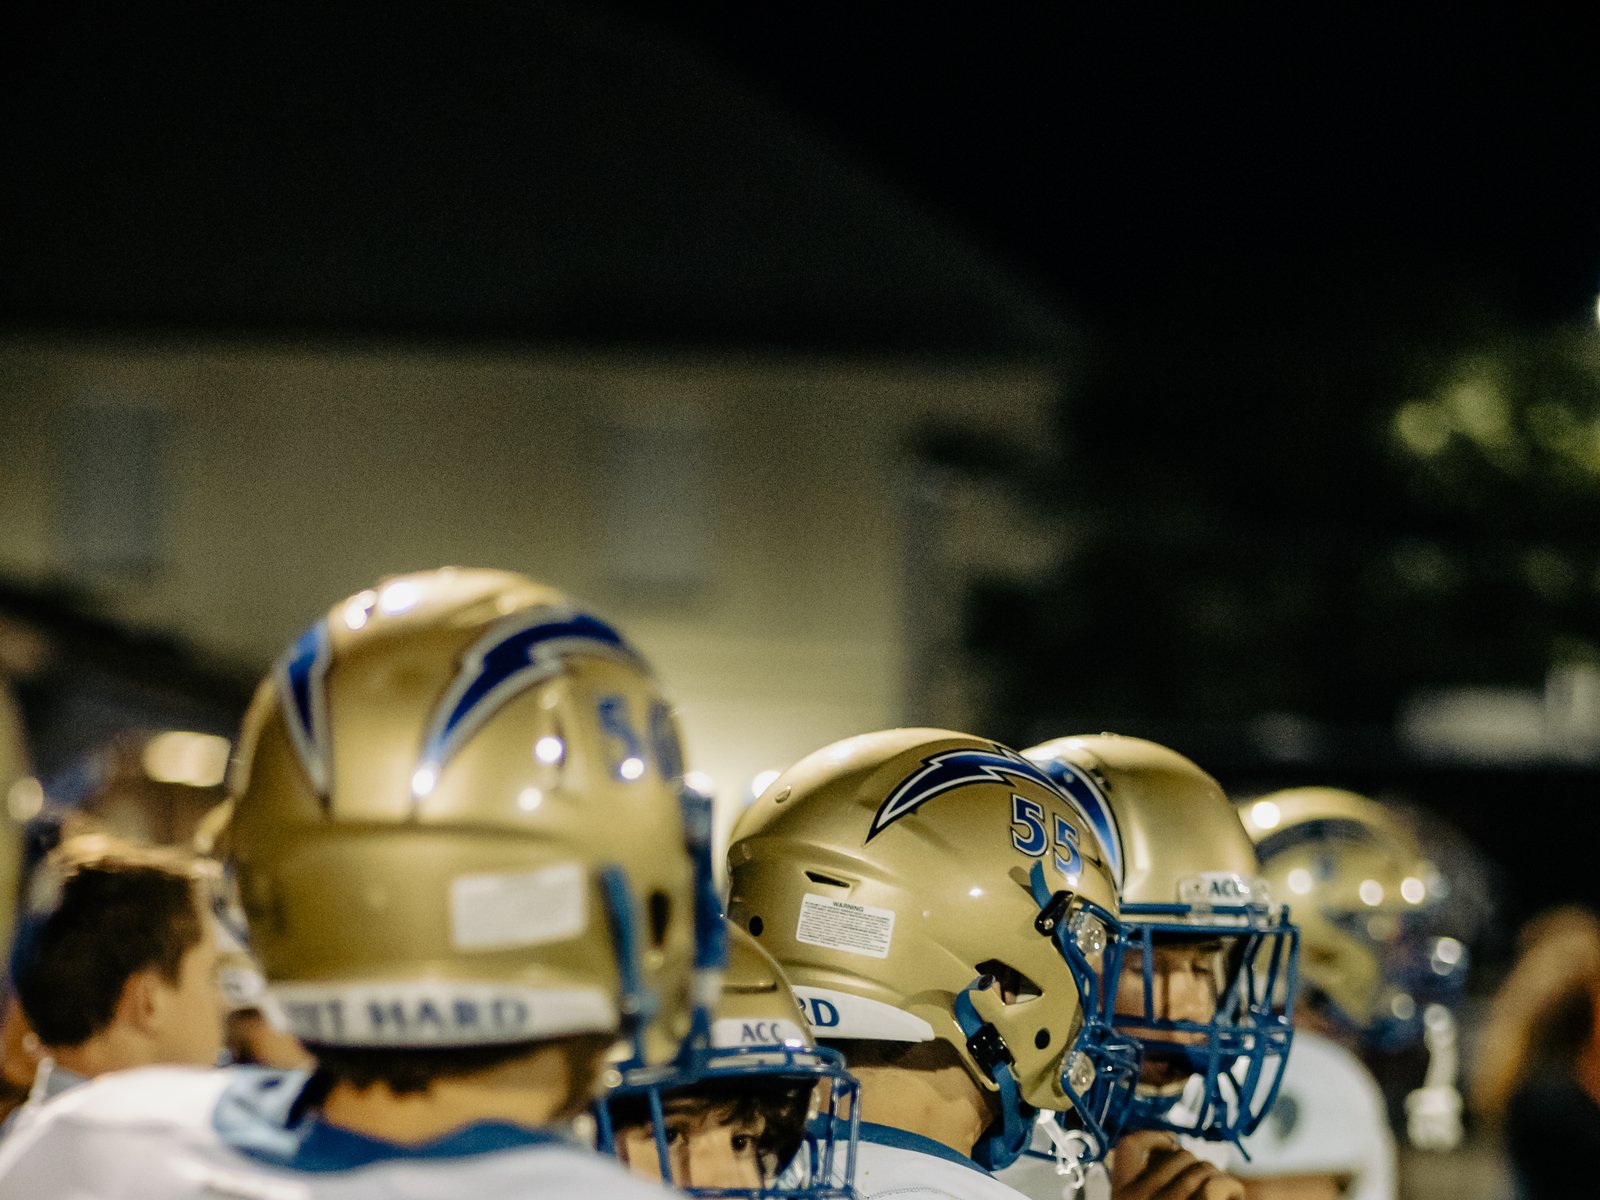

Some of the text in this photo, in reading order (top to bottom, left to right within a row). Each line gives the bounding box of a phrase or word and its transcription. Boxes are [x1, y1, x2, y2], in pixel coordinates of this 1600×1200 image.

[1010, 793, 1084, 878] 55
[833, 901, 864, 912] WARNING
[741, 1022, 782, 1043] ACC
